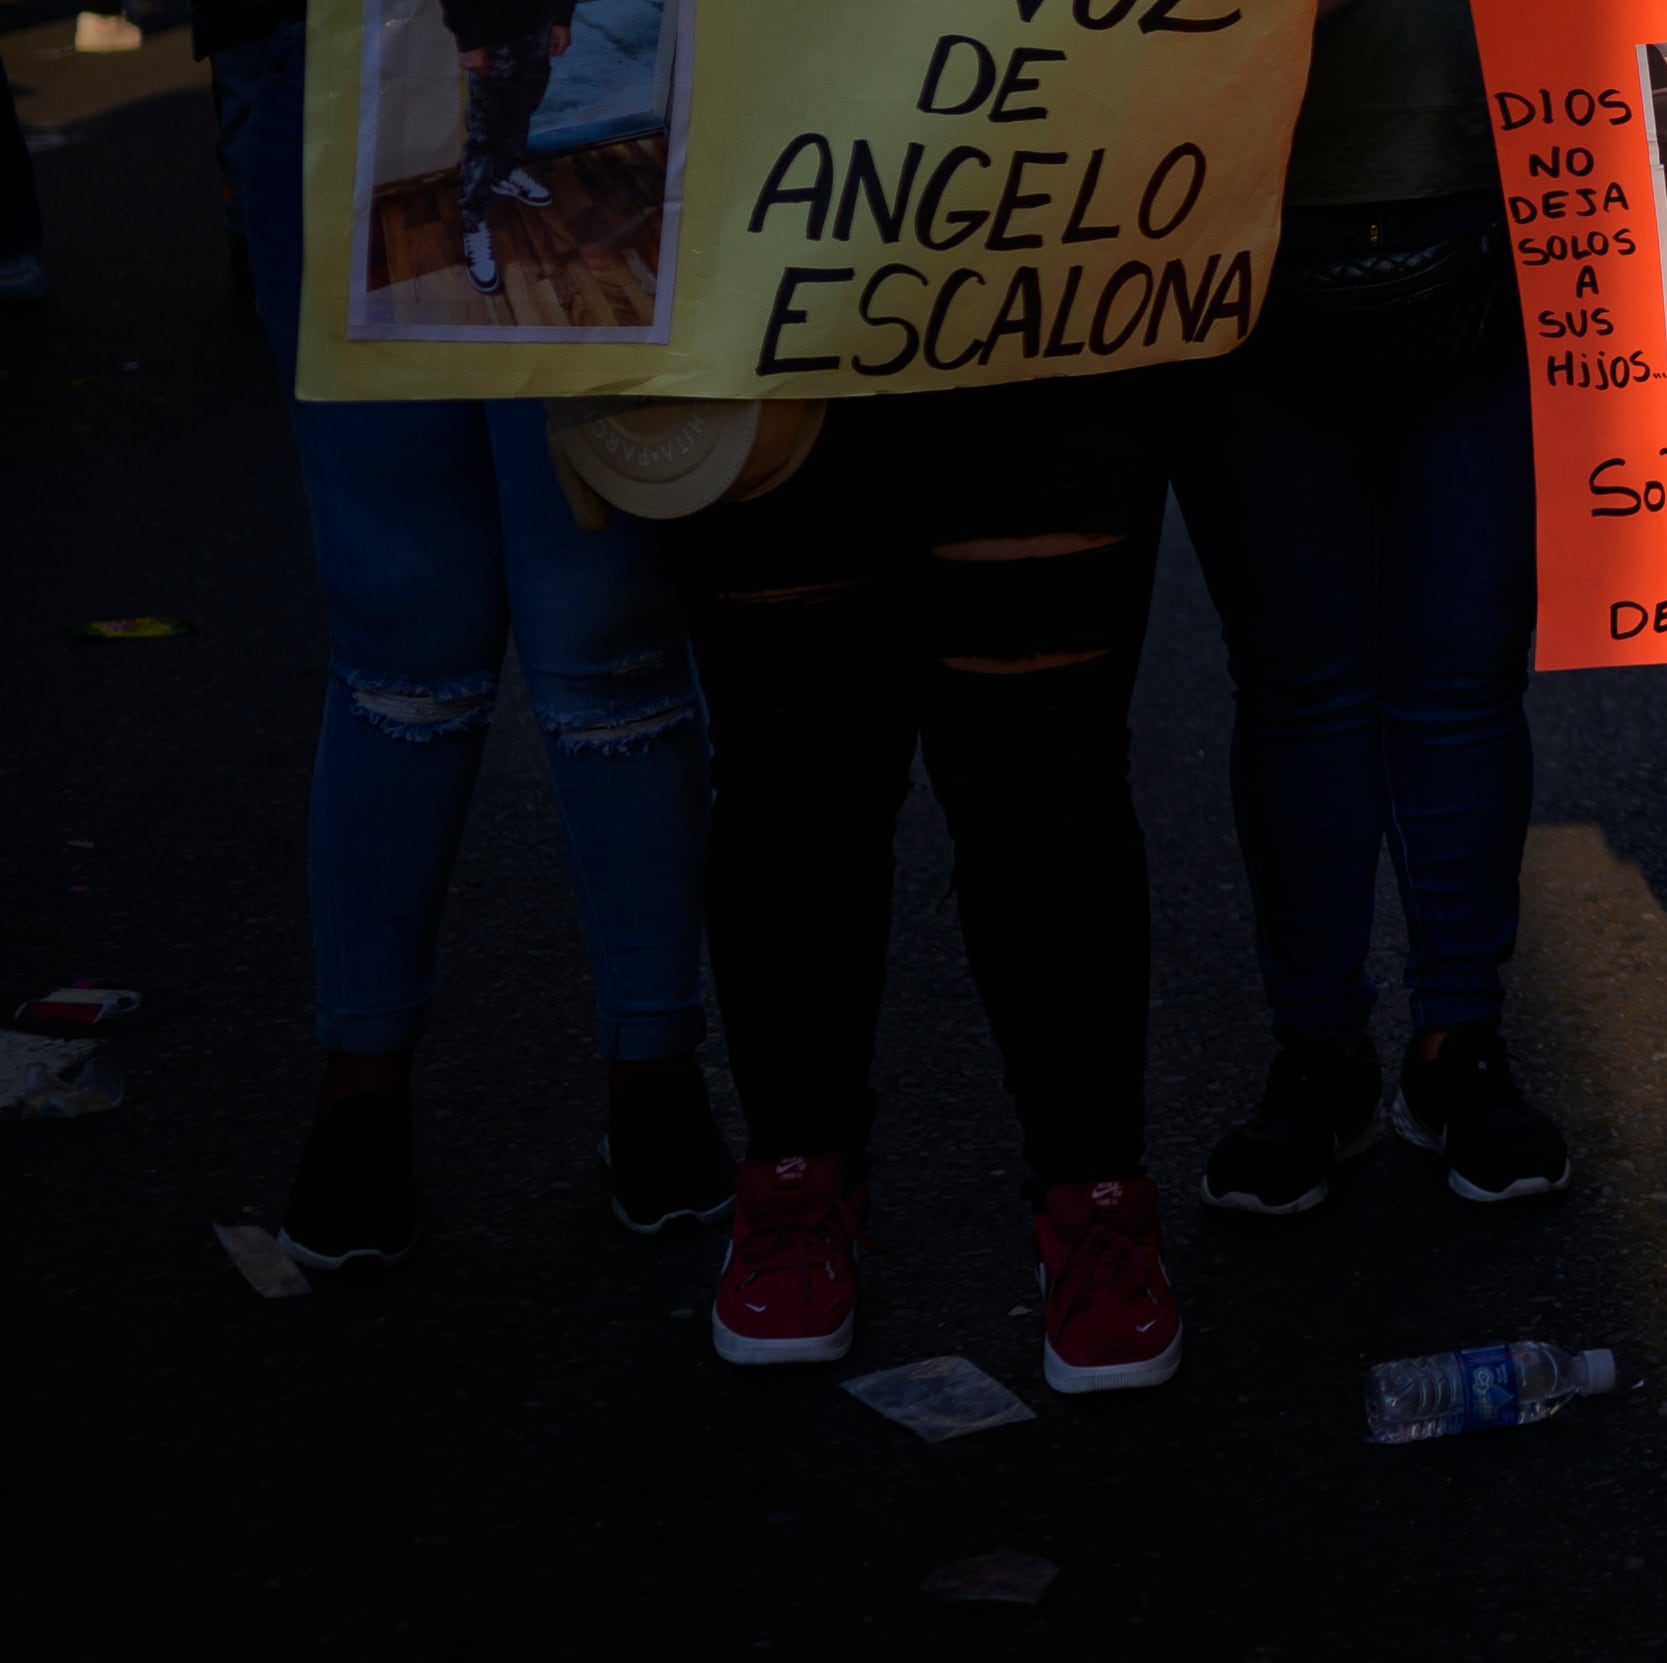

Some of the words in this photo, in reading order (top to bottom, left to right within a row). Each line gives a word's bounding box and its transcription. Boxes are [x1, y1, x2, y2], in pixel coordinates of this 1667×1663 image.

[917, 34, 1068, 124] DE
[1495, 89, 1632, 131] DIOS
[1528, 146, 1594, 178] NO
[747, 133, 1208, 251] ANGELO
[1508, 182, 1629, 225] DEJA
[1517, 228, 1636, 266] SOLOS
[1576, 266, 1599, 298] A
[755, 250, 1253, 377] ESCALONA
[1538, 308, 1614, 337] SUS
